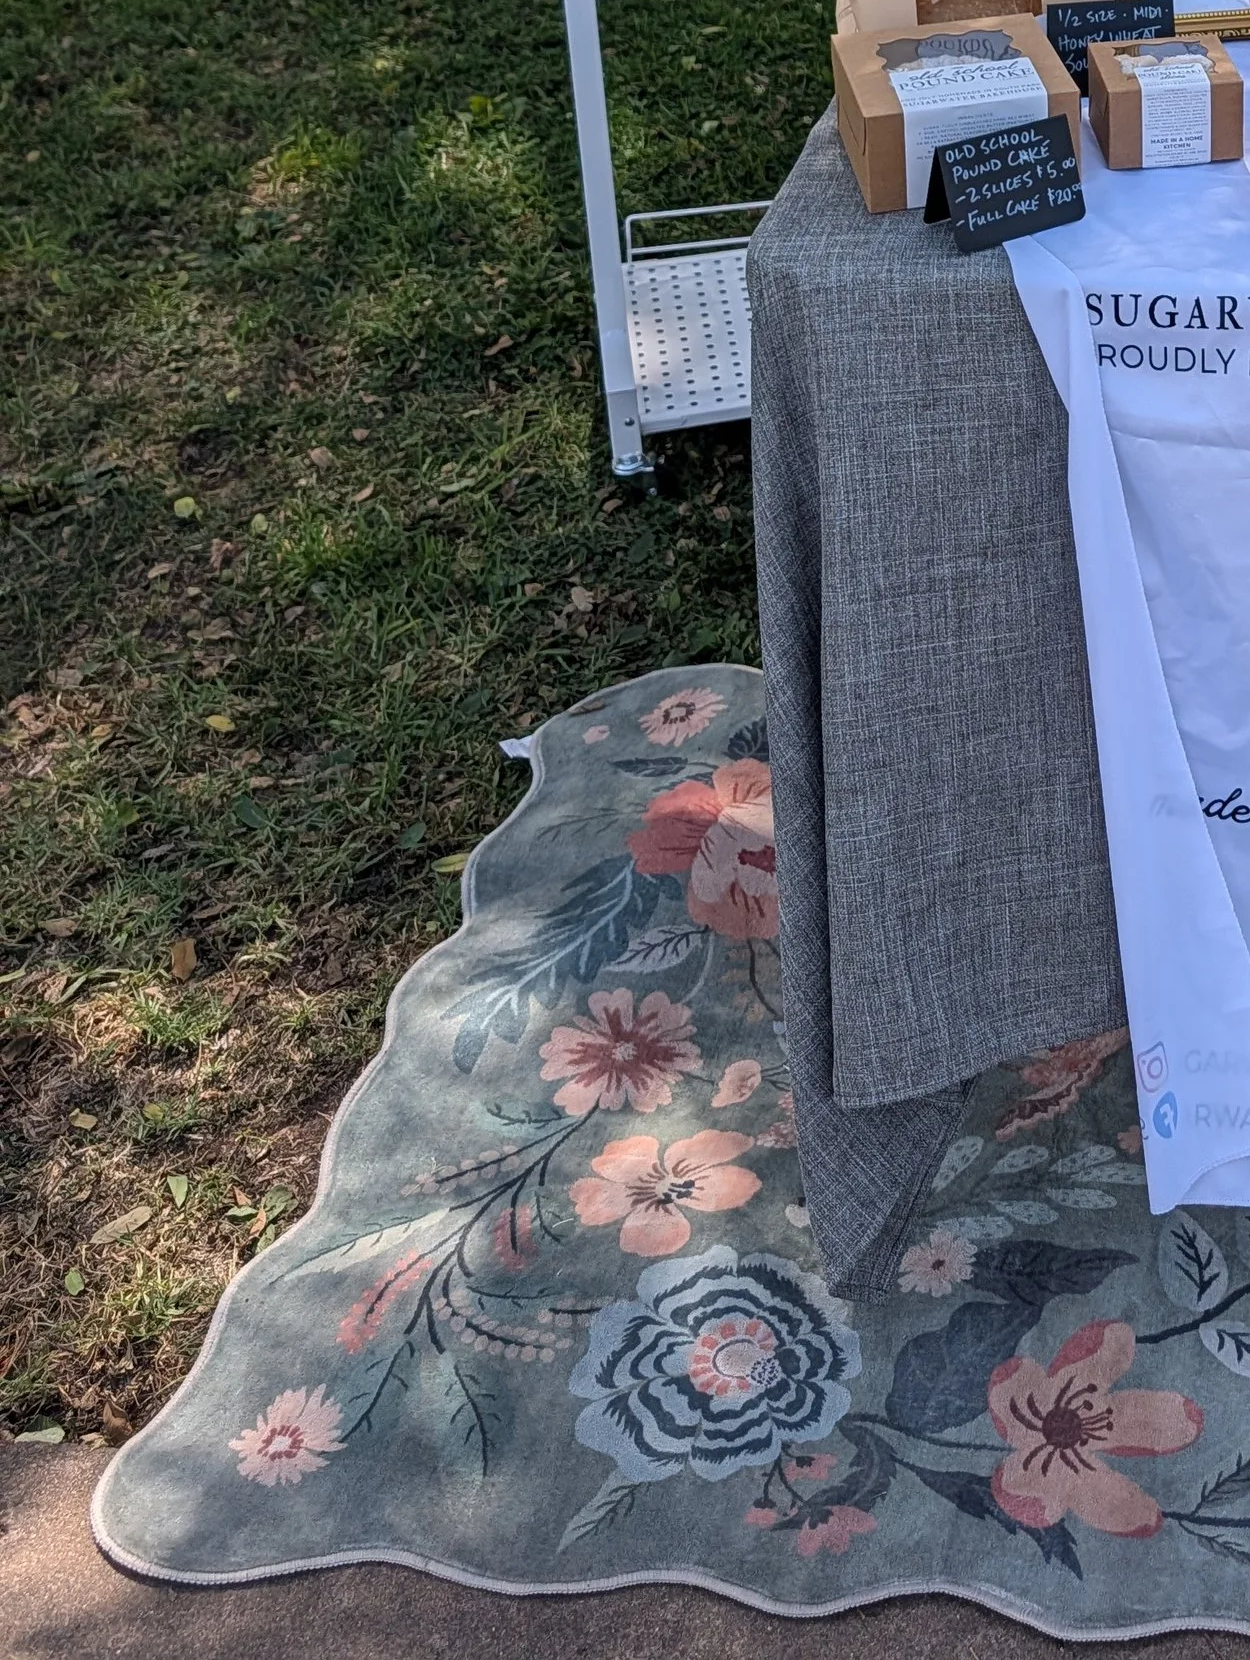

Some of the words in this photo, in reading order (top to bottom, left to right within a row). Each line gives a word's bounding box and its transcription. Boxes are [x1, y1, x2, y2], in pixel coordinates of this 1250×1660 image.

[1058, 8, 1082, 28] 1/2
[1086, 9, 1117, 23] SIZE
[1133, 6, 1162, 21] MIDI
[1058, 30, 1104, 52] HONEY
[899, 74, 975, 91] POUND
[980, 67, 1035, 81] CAKE
[908, 68, 944, 81] old
[952, 60, 1019, 77] school
[980, 86, 1043, 99] BAKEHOUSE
[945, 144, 976, 163] OLD
[980, 128, 1043, 155] SCHOOL
[1150, 137, 1169, 145] MADE
[952, 159, 1001, 185] POUND
[1007, 139, 1050, 166] CAKE
[982, 170, 1033, 200] SLICES
[1006, 194, 1040, 216] CAKE
[1097, 343, 1236, 375] ROUDLY
